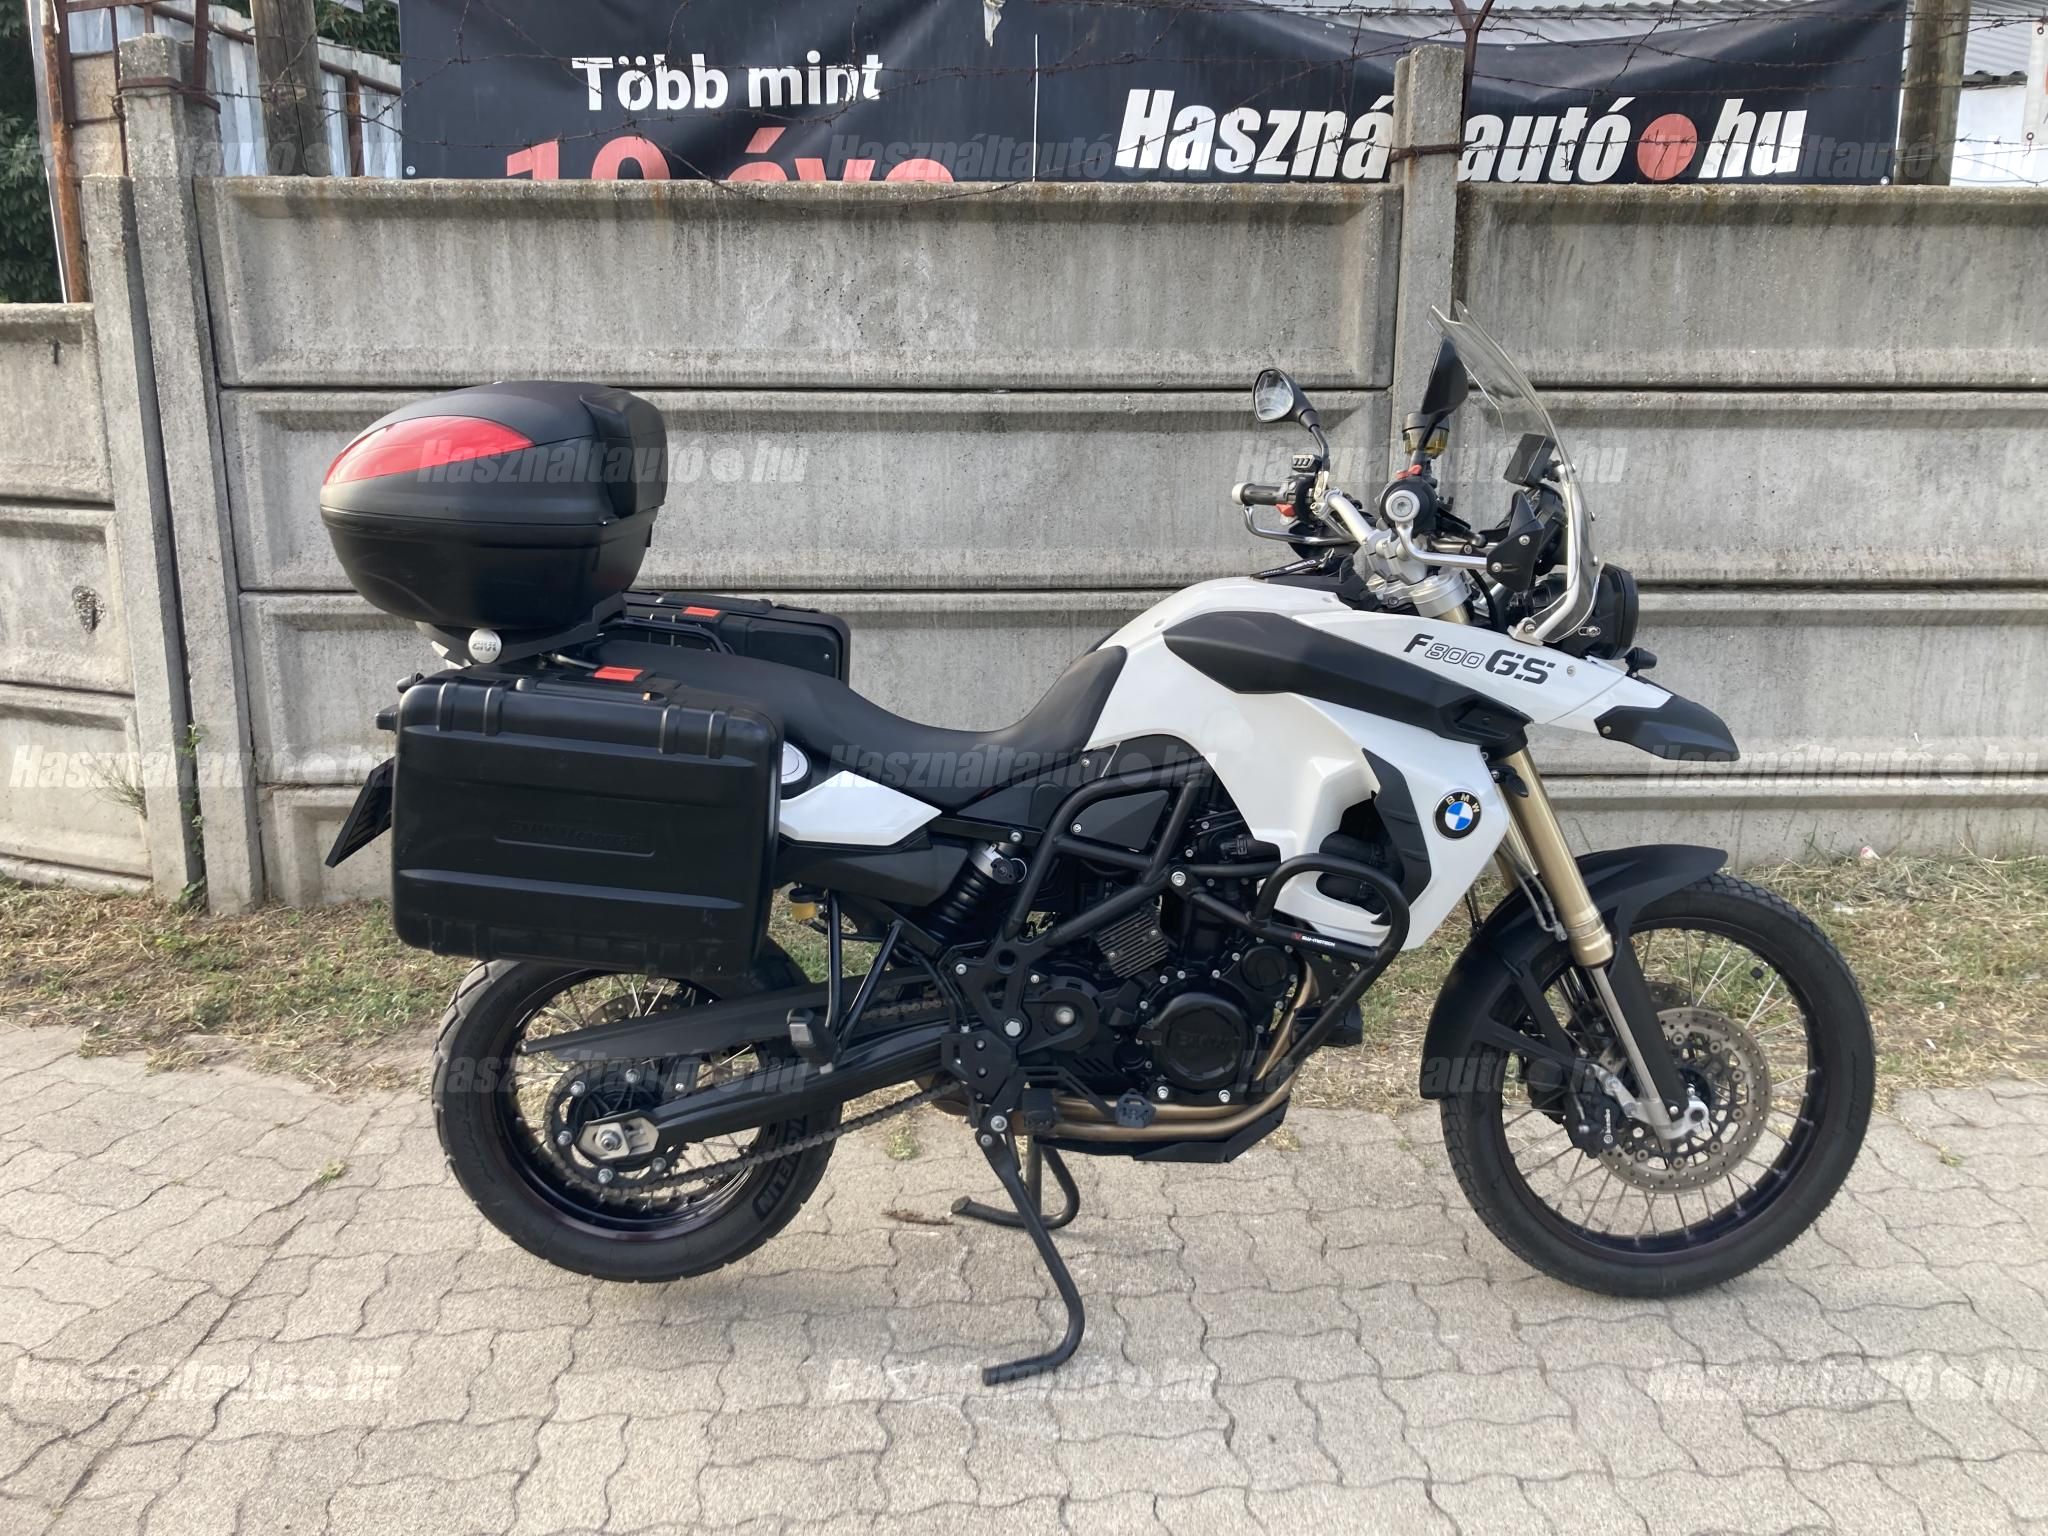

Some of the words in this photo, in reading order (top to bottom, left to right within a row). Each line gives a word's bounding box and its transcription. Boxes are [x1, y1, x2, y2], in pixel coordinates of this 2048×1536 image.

[572, 55, 728, 111] Több
[748, 50, 882, 107] mint
[1446, 793, 1480, 813] BMW
